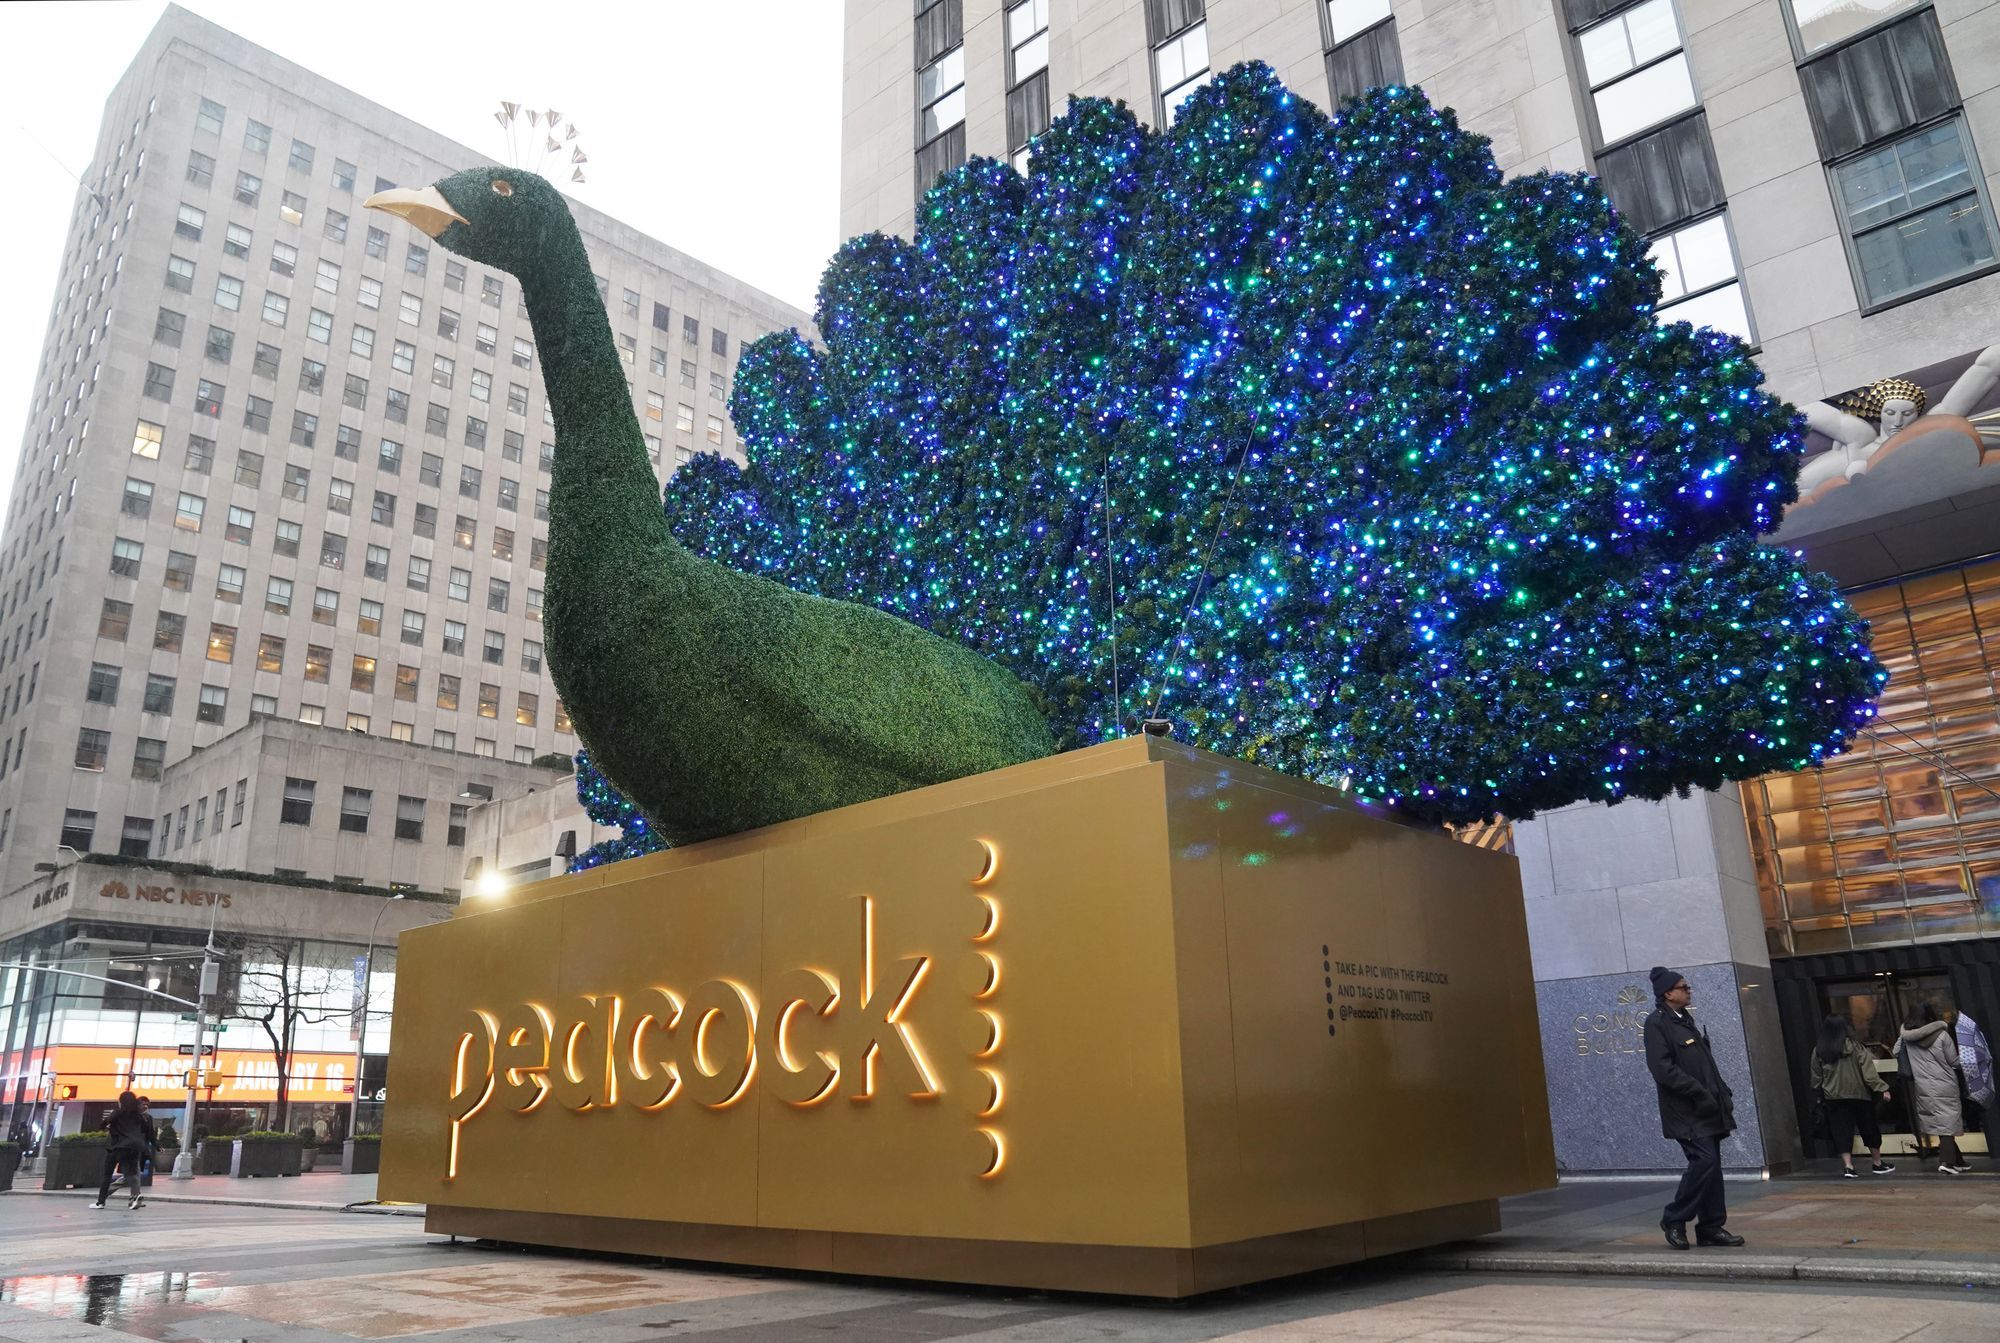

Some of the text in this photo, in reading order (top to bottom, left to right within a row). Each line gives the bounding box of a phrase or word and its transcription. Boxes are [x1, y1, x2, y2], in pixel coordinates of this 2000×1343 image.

[135, 885, 232, 909] NBC NEWS
[1335, 961, 1449, 985] TAKE A PIC WITH THE PEACOCK
[1338, 984, 1431, 1003] AND TAG US ON TWITTER
[1339, 1004, 1433, 1022] @PeacockTV #PeacockTV
[442, 894, 945, 1183] peacock
[325, 1062, 345, 1092] 16
